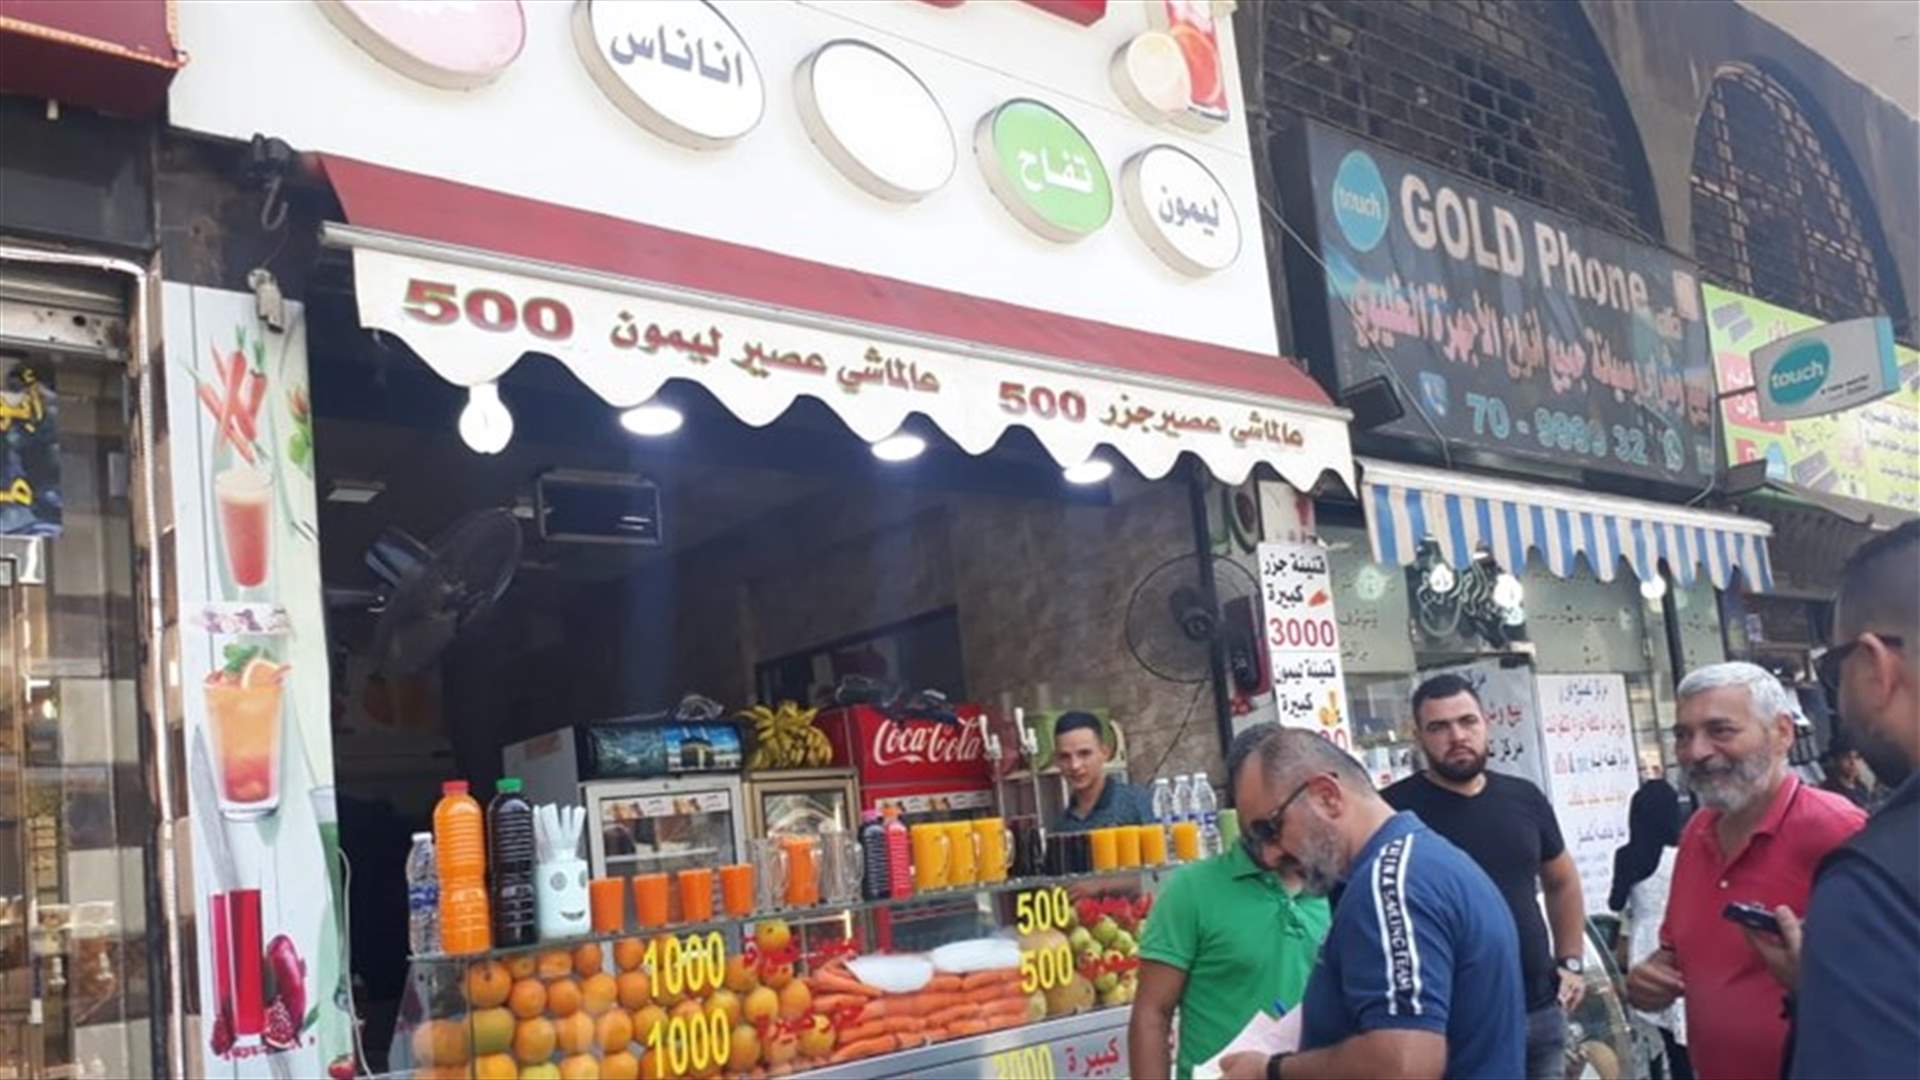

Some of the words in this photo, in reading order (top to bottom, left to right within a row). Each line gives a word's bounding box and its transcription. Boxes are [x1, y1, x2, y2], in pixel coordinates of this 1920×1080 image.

[611, 24, 743, 88] اناناس
[1016, 146, 1093, 194] تفاح
[1158, 186, 1219, 236] ليمون
[1340, 187, 1381, 217] touch
[1401, 174, 1524, 278] GOLD
[1533, 222, 1649, 314] Phone
[403, 278, 573, 341] 500
[610, 311, 722, 364] ليمون
[731, 341, 827, 378] عصير
[837, 347, 940, 394] عالماشي
[1770, 361, 1824, 387] touch
[999, 381, 1087, 423] 500
[1230, 411, 1303, 448] عالماشي
[1466, 392, 1510, 440] 70
[1612, 424, 1649, 466] 32
[1264, 553, 1287, 577] جزر
[1292, 553, 1326, 579] قنينة
[1266, 584, 1304, 609] كبيرة
[1269, 617, 1335, 648] 3000
[1307, 659, 1335, 684] قنينة
[1280, 692, 1313, 718] كبيرة
[873, 716, 982, 766] Coca-Cola
[1017, 887, 1071, 935] 500
[643, 931, 725, 998] 1000
[1021, 944, 1073, 993] 500
[648, 1008, 731, 1080] 1000
[1066, 1036, 1120, 1077] كبيرة
